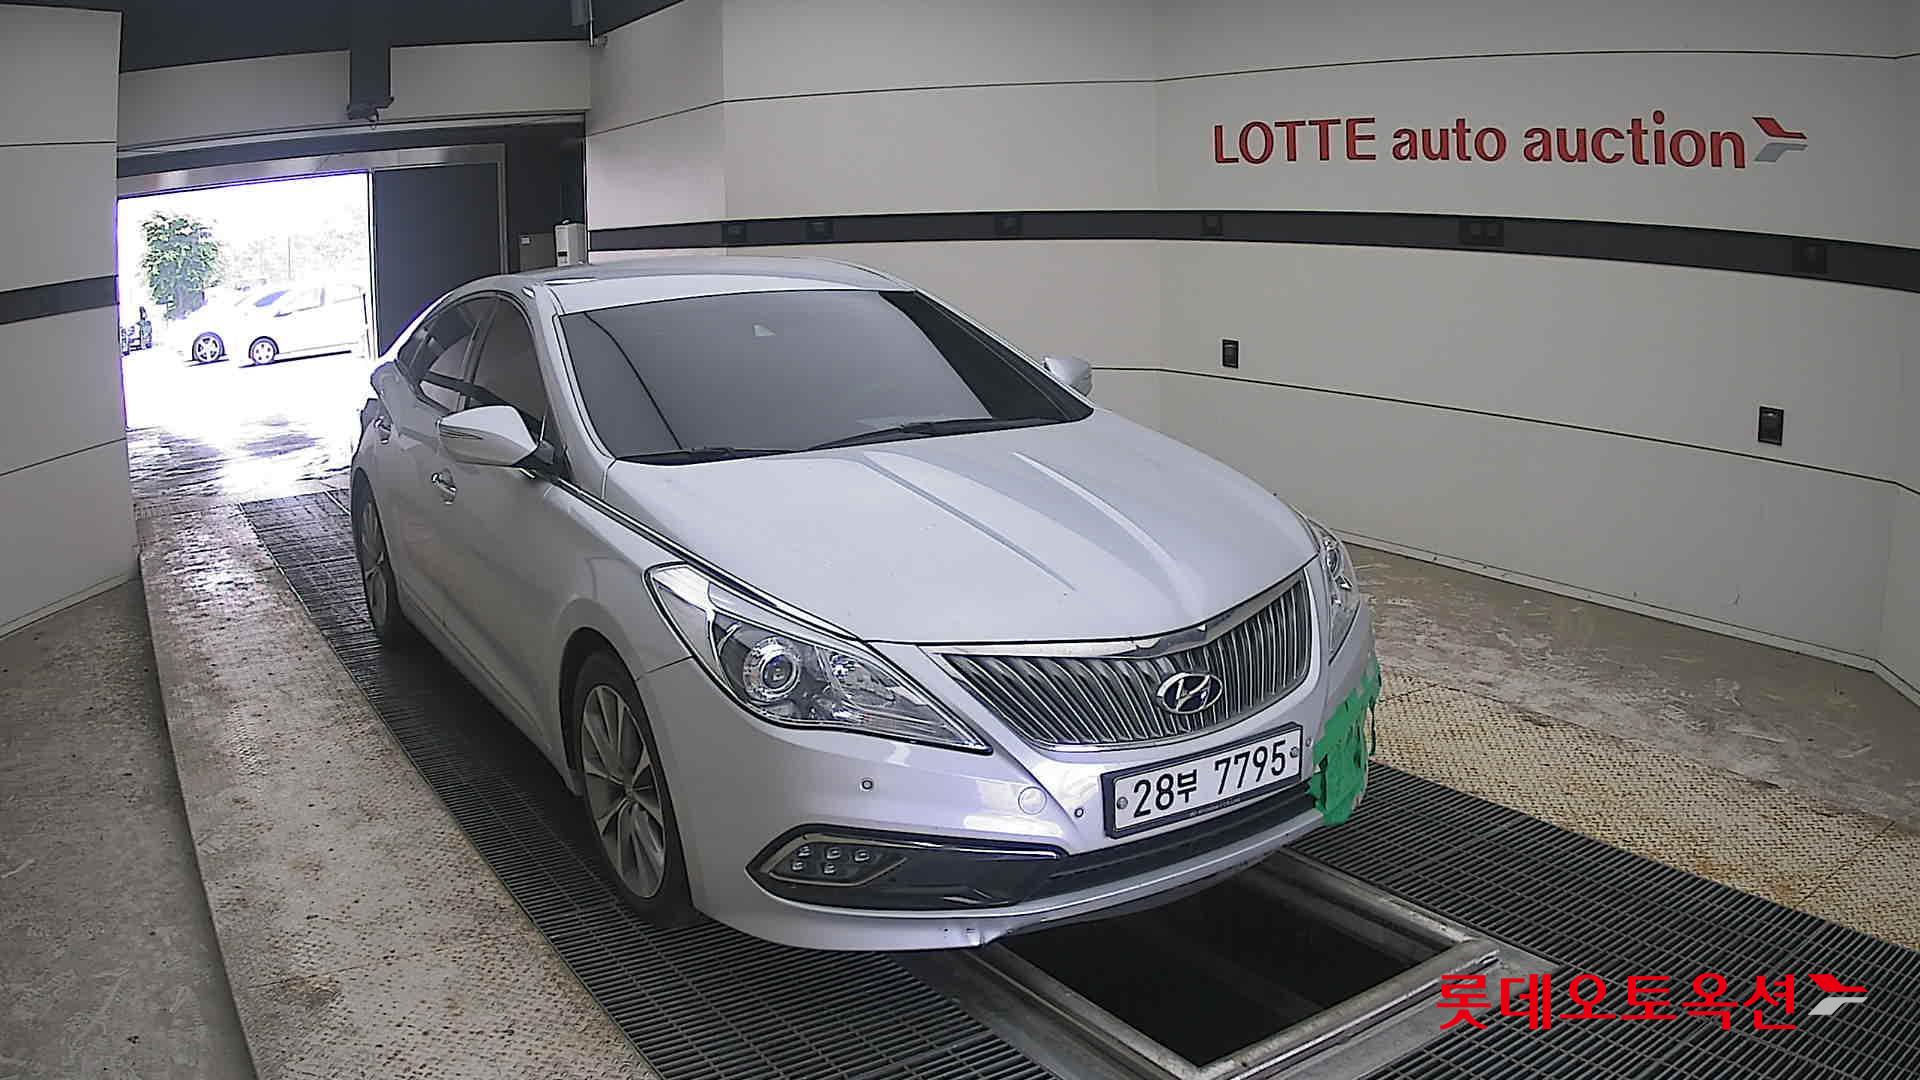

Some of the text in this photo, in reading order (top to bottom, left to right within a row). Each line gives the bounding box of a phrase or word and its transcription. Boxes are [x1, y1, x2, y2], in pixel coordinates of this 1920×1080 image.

[1213, 111, 1746, 168] LOTTE auto auction
[1133, 769, 1198, 818] 28부
[1214, 740, 1286, 795] 7795
